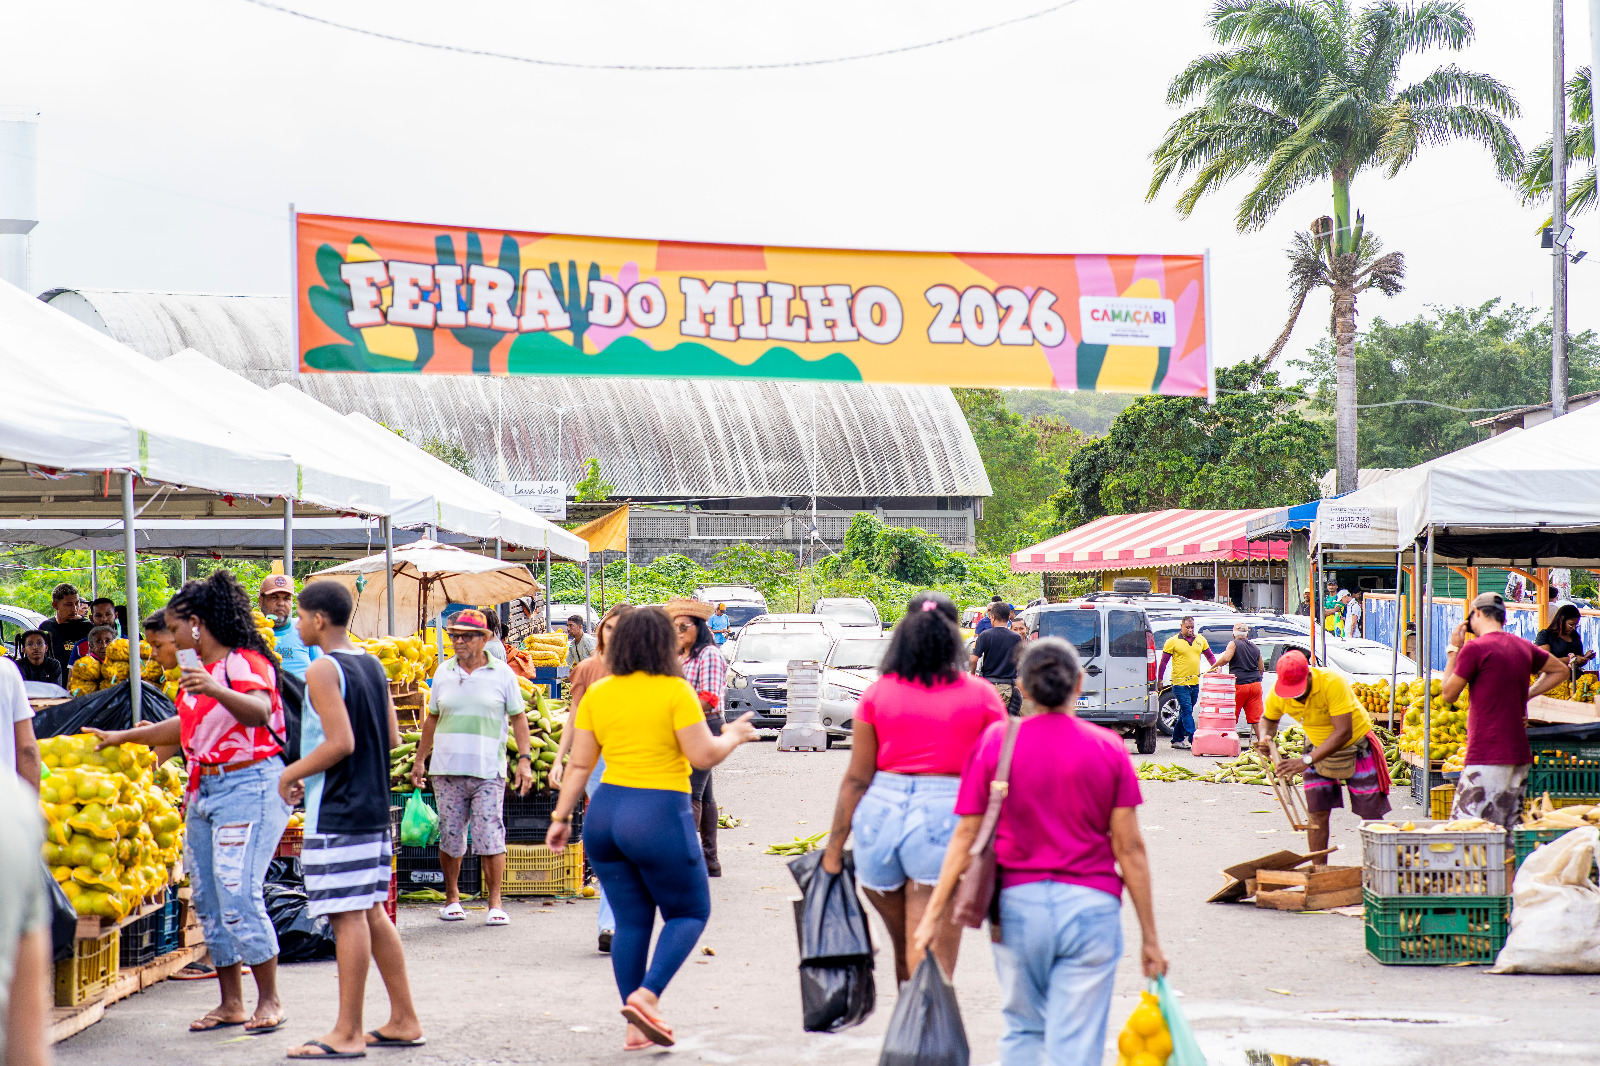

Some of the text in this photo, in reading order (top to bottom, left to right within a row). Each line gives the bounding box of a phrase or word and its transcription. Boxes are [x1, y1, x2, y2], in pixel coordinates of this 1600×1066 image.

[340, 260, 1066, 347] FEIRA DO MILHO 2026
[1090, 309, 1166, 326] CAMAÇARI
[514, 483, 535, 495] Lava
[1160, 566, 1214, 577] LANCHONETE
[1220, 566, 1247, 578] VIVO
[1250, 567, 1270, 578] PELA
